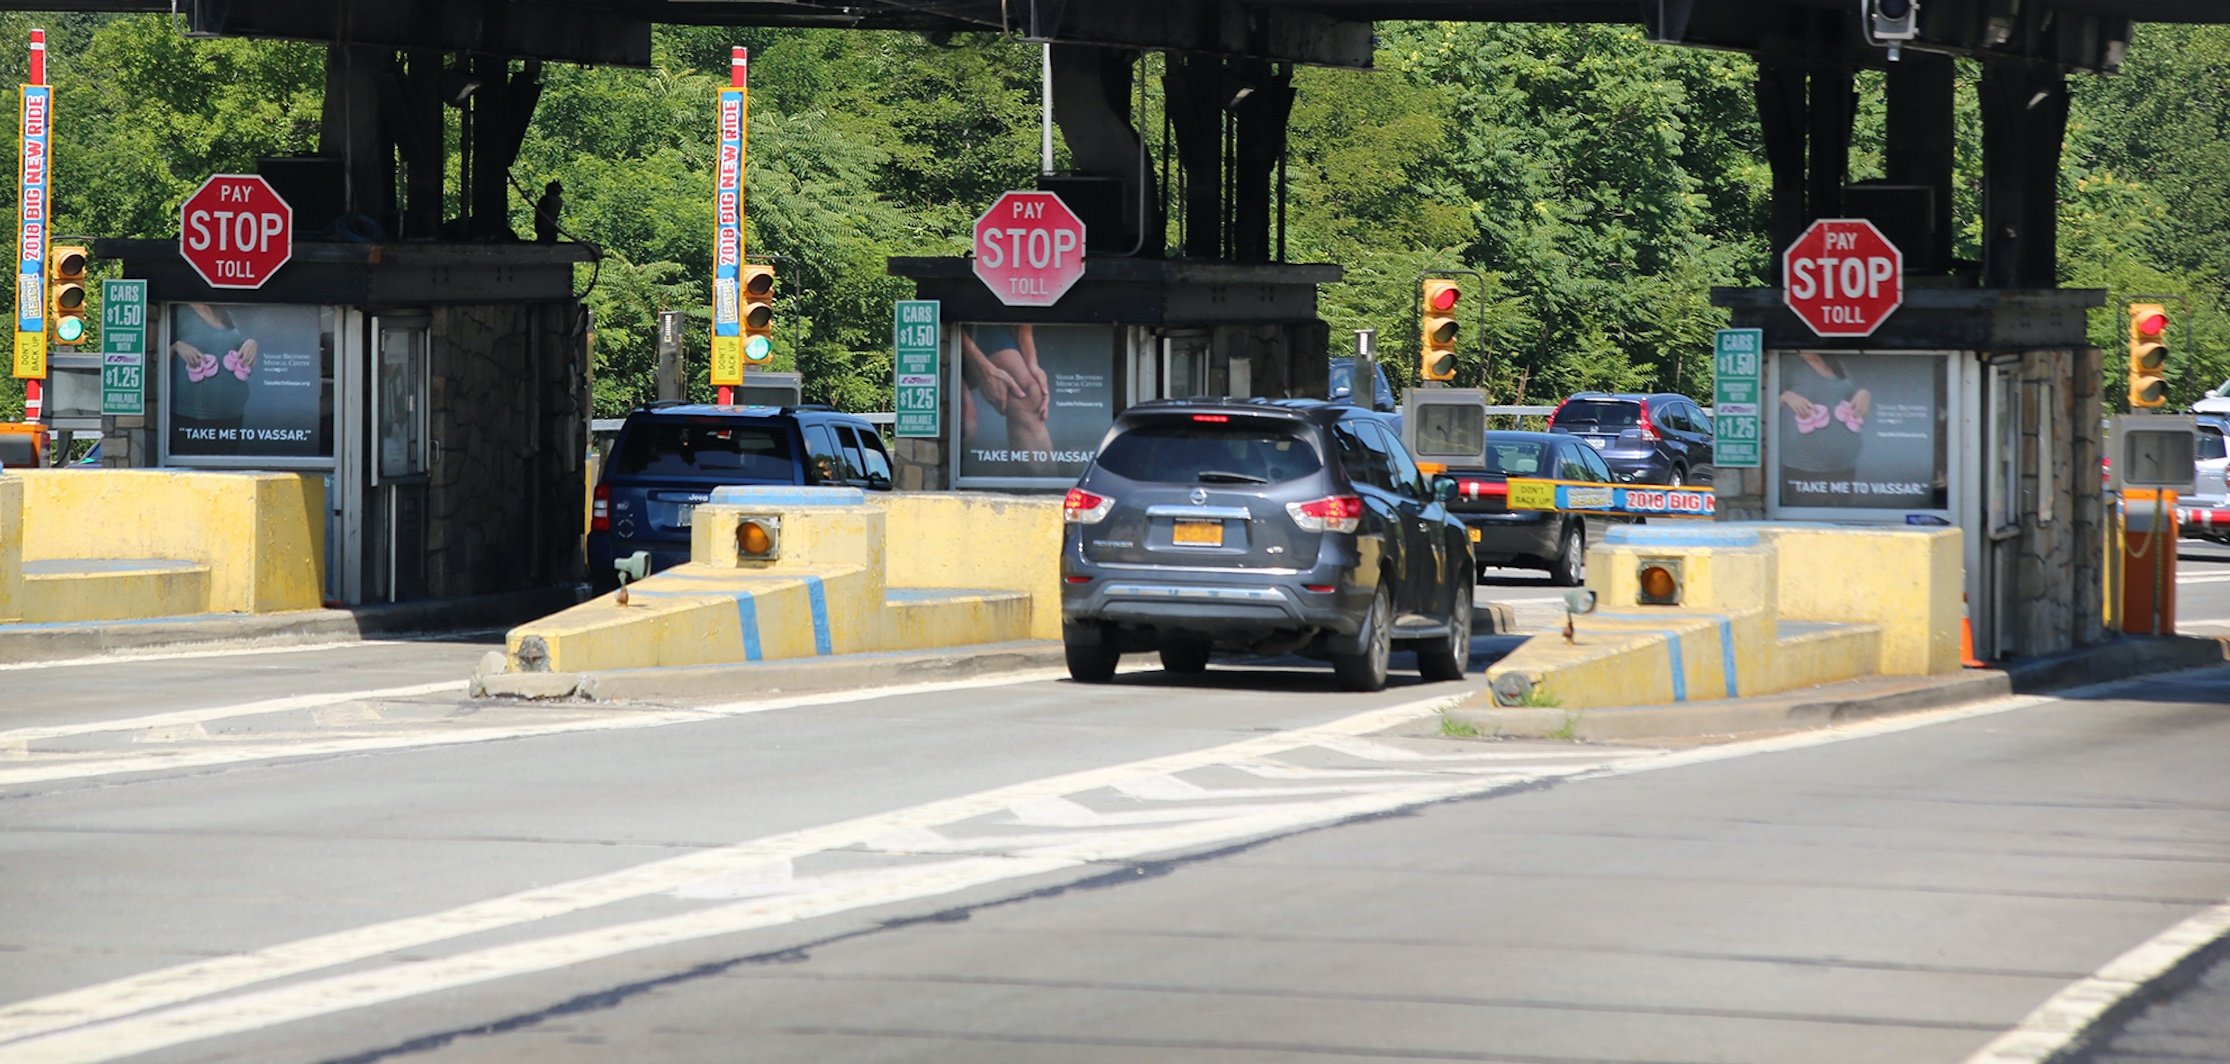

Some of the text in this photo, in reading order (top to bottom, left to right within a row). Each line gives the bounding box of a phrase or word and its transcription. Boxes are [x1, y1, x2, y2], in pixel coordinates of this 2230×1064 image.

[24, 95, 43, 261] 2018 BIG NEW RIDE
[720, 100, 738, 265] 2018 BIG NEW RIDE
[221, 185, 252, 202] PAY
[1012, 202, 1044, 219] PAY
[189, 210, 283, 252] STOP
[1826, 232, 1857, 250] PAY
[982, 227, 1076, 269] STOP
[215, 260, 255, 278] TOLL
[1791, 257, 1893, 300] STOP
[110, 285, 139, 302] CARS
[1009, 278, 1048, 294] TOLL
[107, 304, 141, 326] $1.50
[903, 306, 932, 323] CARS
[1821, 305, 1866, 324] TOLL
[900, 325, 934, 347] $1.50
[1722, 334, 1754, 351] CARS
[21, 342, 29, 366] DON'T
[31, 336, 40, 372] BACK UP
[718, 347, 726, 370] DON'T
[728, 341, 736, 376] BACK UP
[1719, 353, 1756, 376] $1.50
[105, 366, 140, 388] $1.25
[900, 387, 934, 409] $1.25
[220, 429, 237, 440] ME
[240, 429, 255, 440] TO
[1718, 416, 1756, 439] $1.25
[1011, 450, 1029, 461] ME
[1032, 450, 1047, 461] TO
[1520, 485, 1545, 495] DON'T
[1830, 481, 1849, 494] ME
[1852, 482, 1869, 494] TO
[1514, 496, 1551, 505] BACK UP
[1669, 494, 1700, 511] BIG
